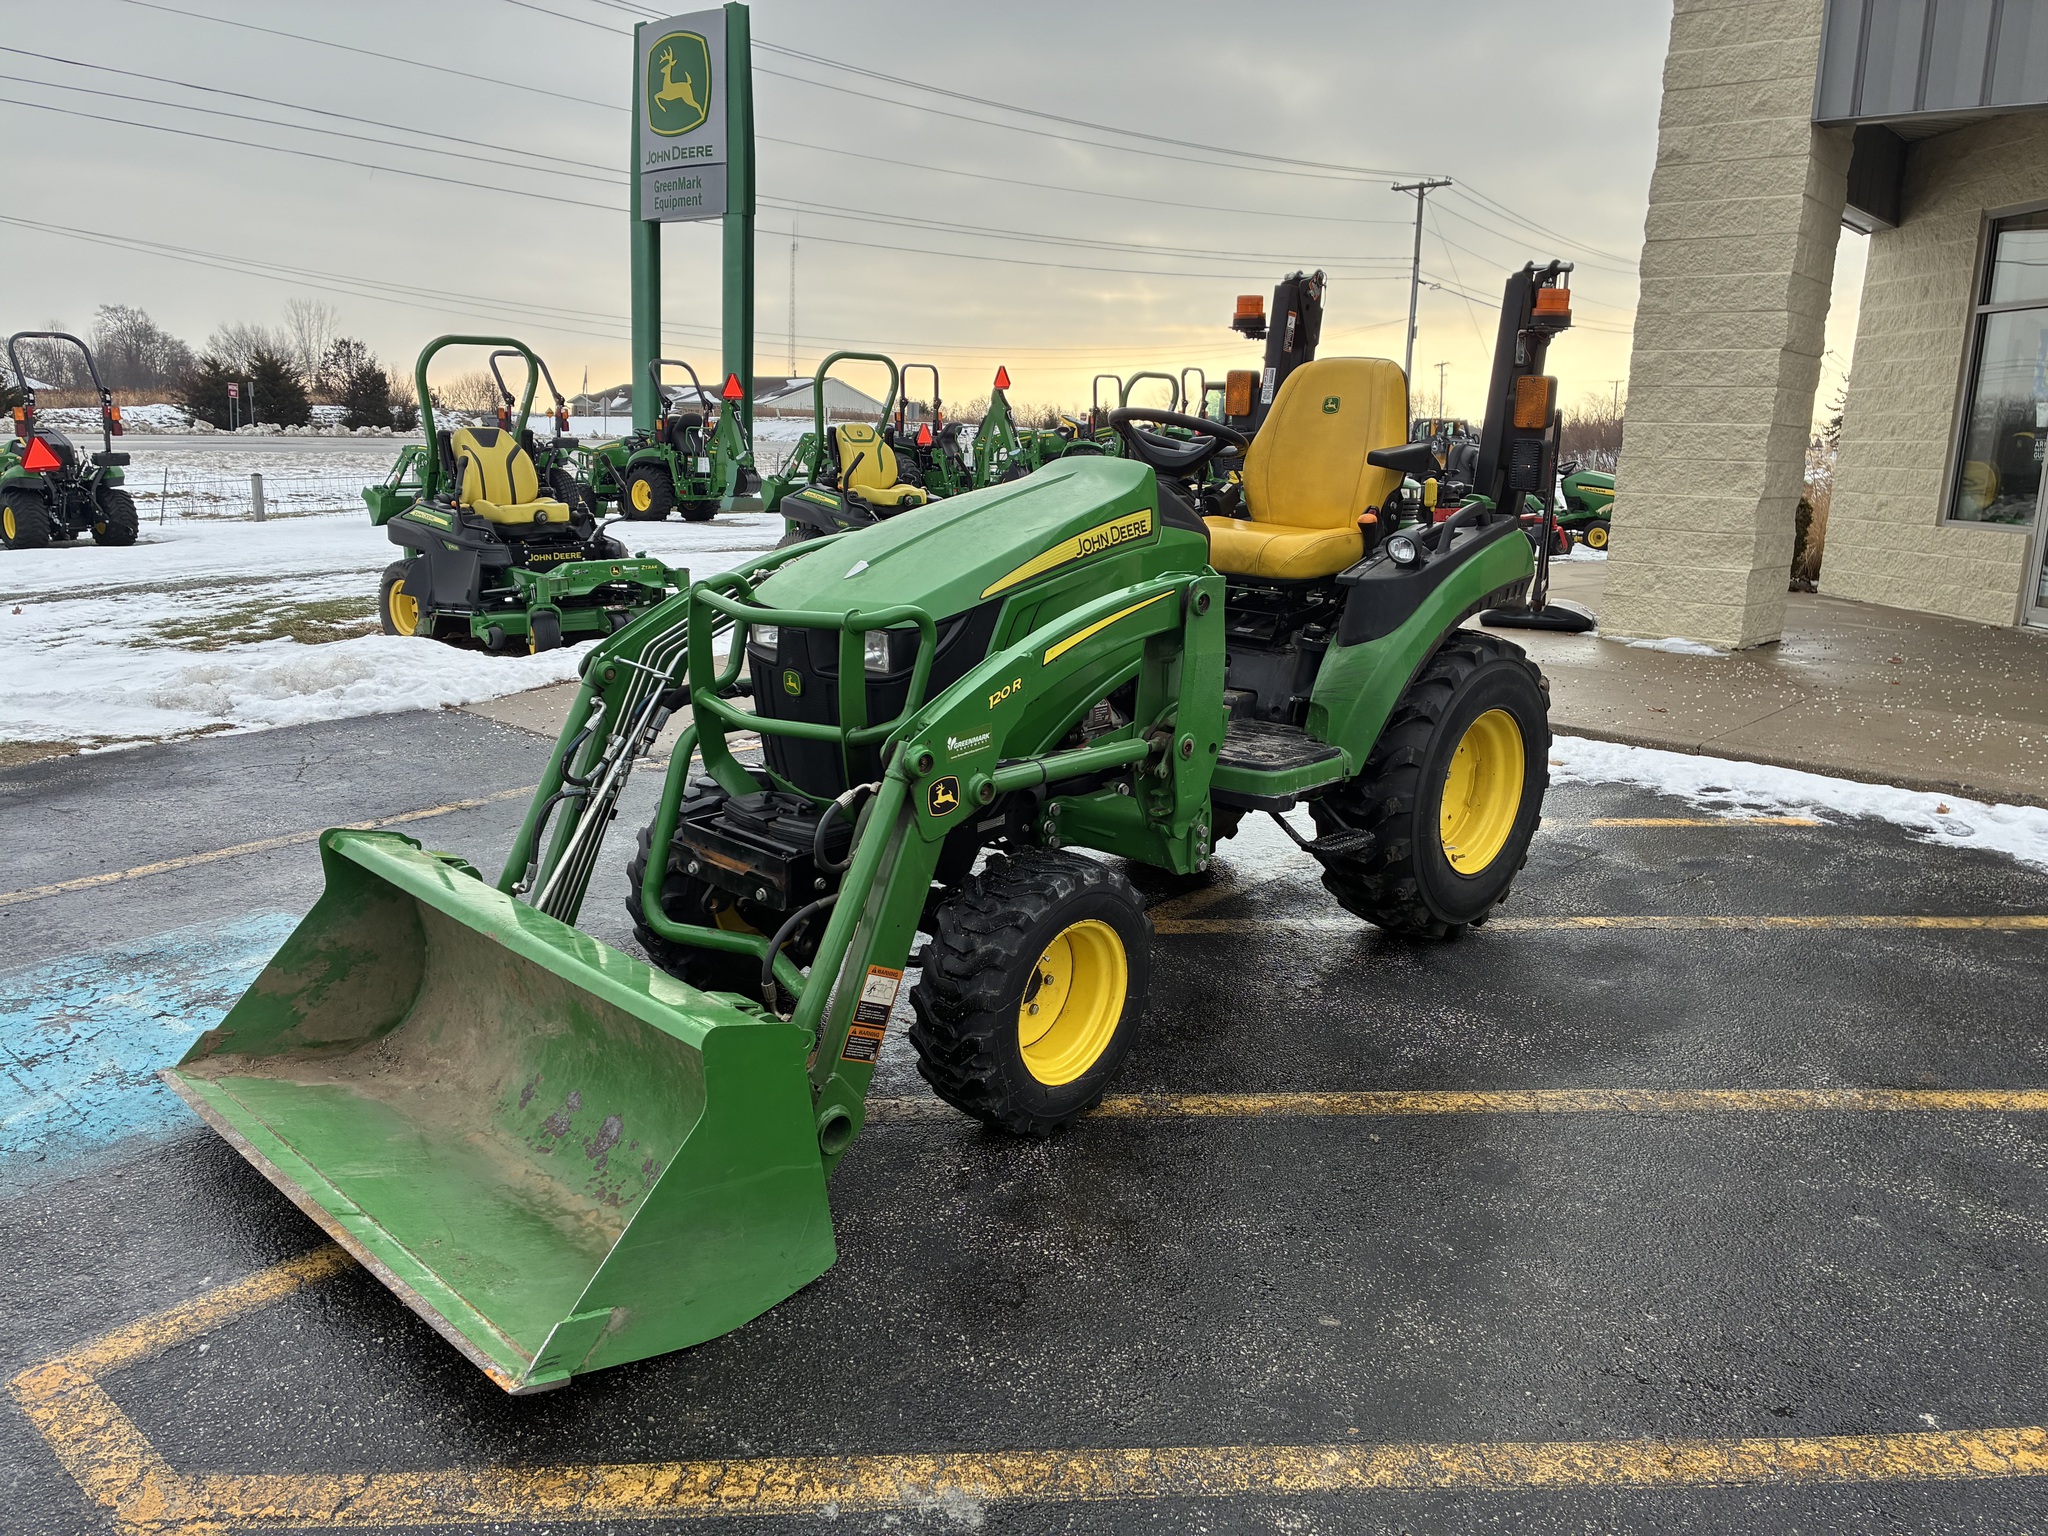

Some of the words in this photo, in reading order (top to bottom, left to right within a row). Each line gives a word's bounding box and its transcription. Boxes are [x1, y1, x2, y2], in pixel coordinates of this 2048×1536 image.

[646, 149, 671, 166] JOHN
[672, 144, 713, 161] DEERE
[654, 175, 702, 193] GreenMark
[654, 193, 702, 211] Equipment
[1076, 531, 1109, 556] JOHN
[1109, 519, 1148, 543] DEERE
[528, 553, 552, 562] JOHN
[553, 551, 582, 560] DEERE
[953, 732, 991, 750] GREENMARK
[877, 968, 899, 978] WARNING
[858, 1029, 880, 1038] WARNING
